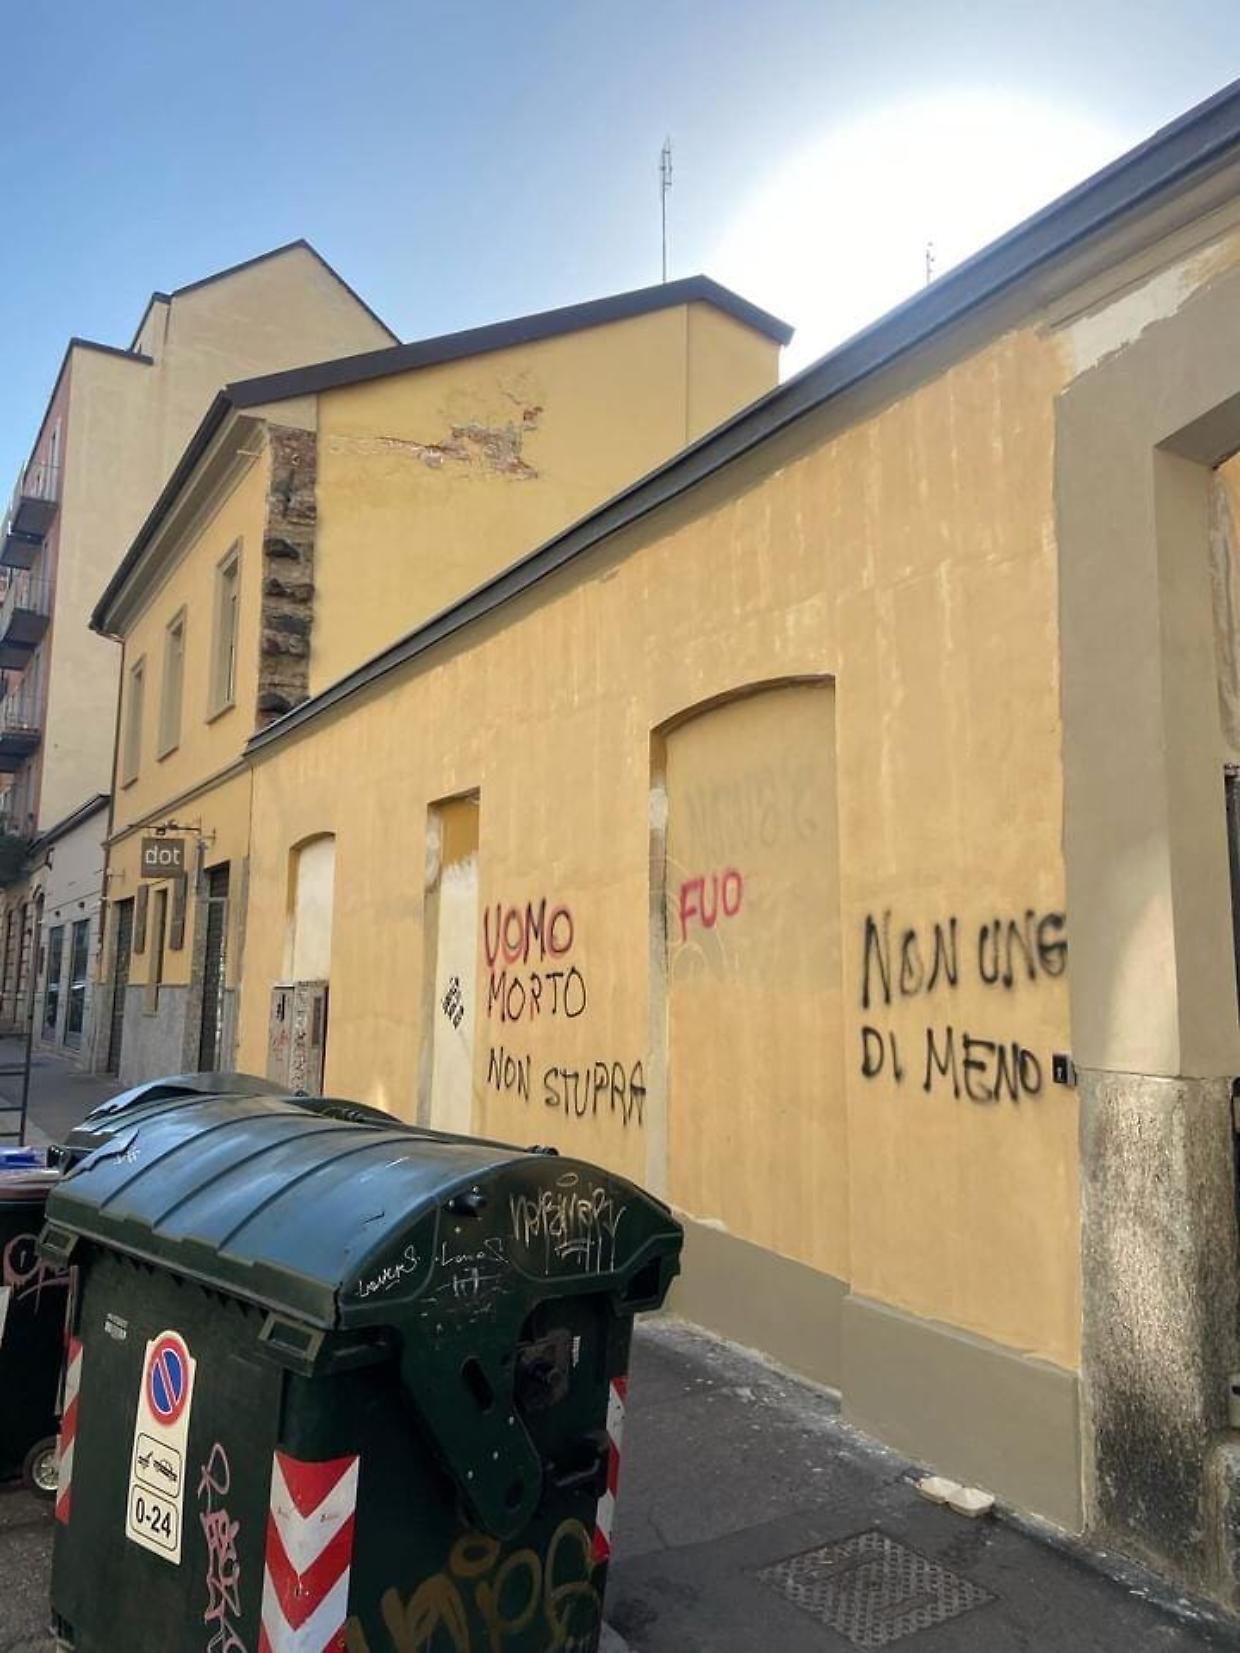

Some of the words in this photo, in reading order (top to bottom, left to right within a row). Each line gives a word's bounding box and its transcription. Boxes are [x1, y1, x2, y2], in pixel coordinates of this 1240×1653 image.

[145, 845, 180, 865] dot
[484, 898, 575, 967] UOMO
[680, 867, 743, 944] FUO
[488, 966, 587, 1022] MORTO
[862, 911, 958, 1009] NON
[487, 1046, 530, 1101] NON
[543, 1060, 647, 1126] STUPRA
[861, 1025, 903, 1083] DI
[923, 1025, 1043, 1105] MENO
[135, 1497, 172, 1538] 0-24
